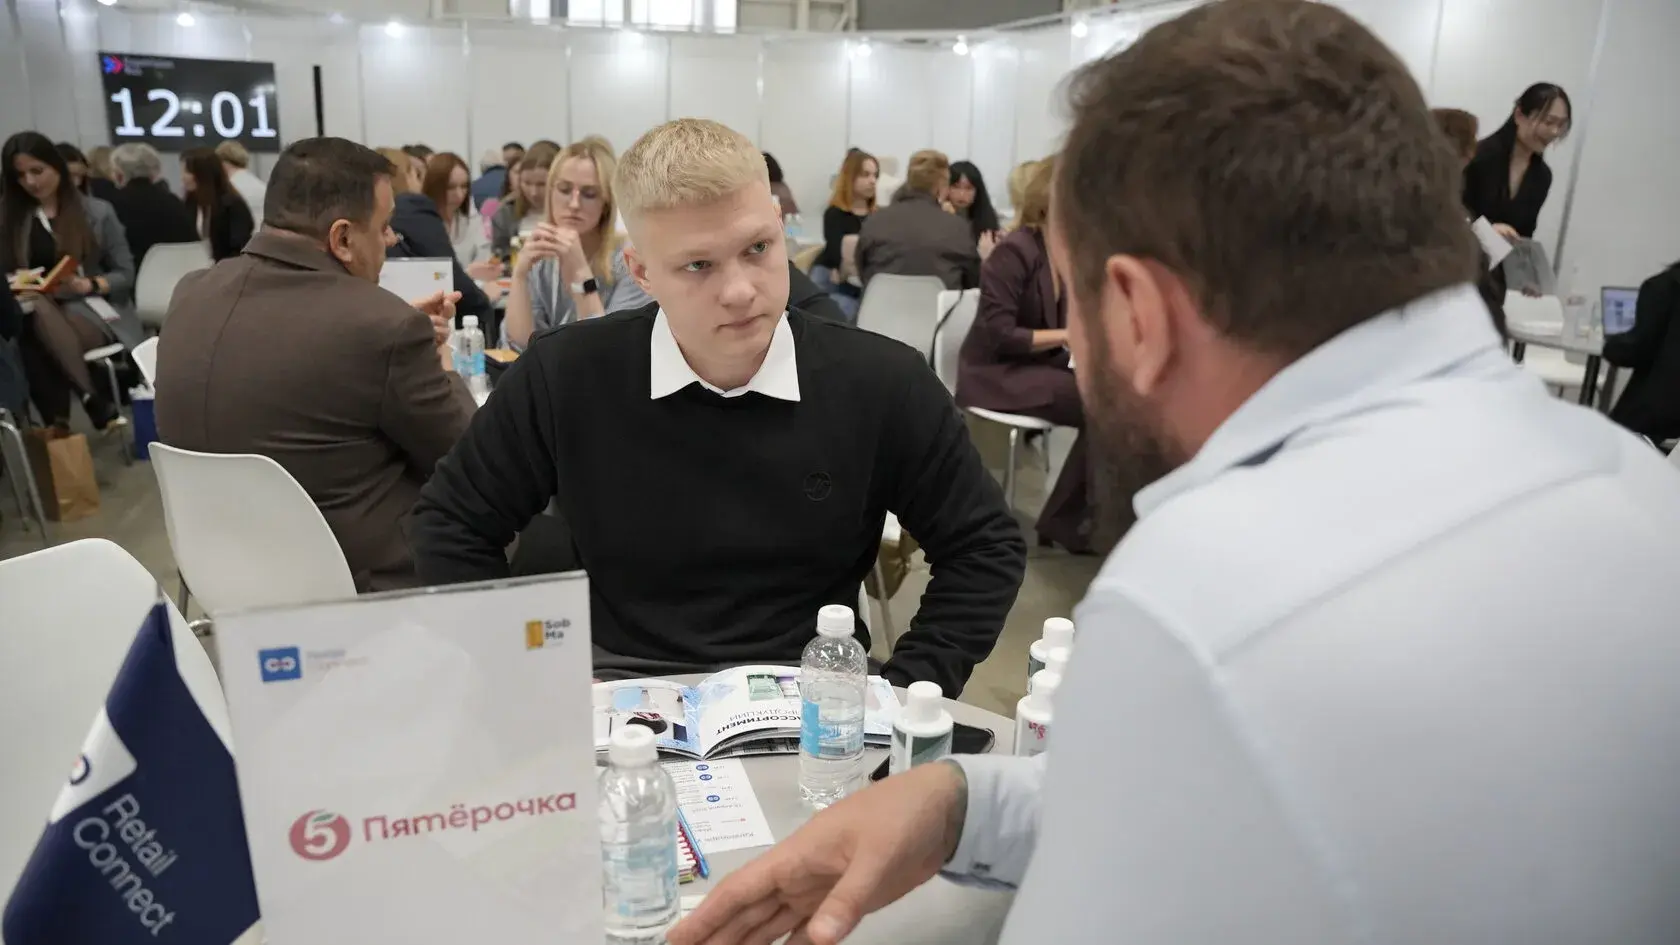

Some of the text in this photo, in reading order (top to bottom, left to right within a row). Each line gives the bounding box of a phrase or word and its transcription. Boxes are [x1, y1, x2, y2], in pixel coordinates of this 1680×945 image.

[111, 87, 277, 138] 12:01
[102, 793, 179, 878] Retail
[362, 792, 577, 842] Пятёрочка
[73, 817, 177, 937] Connect
